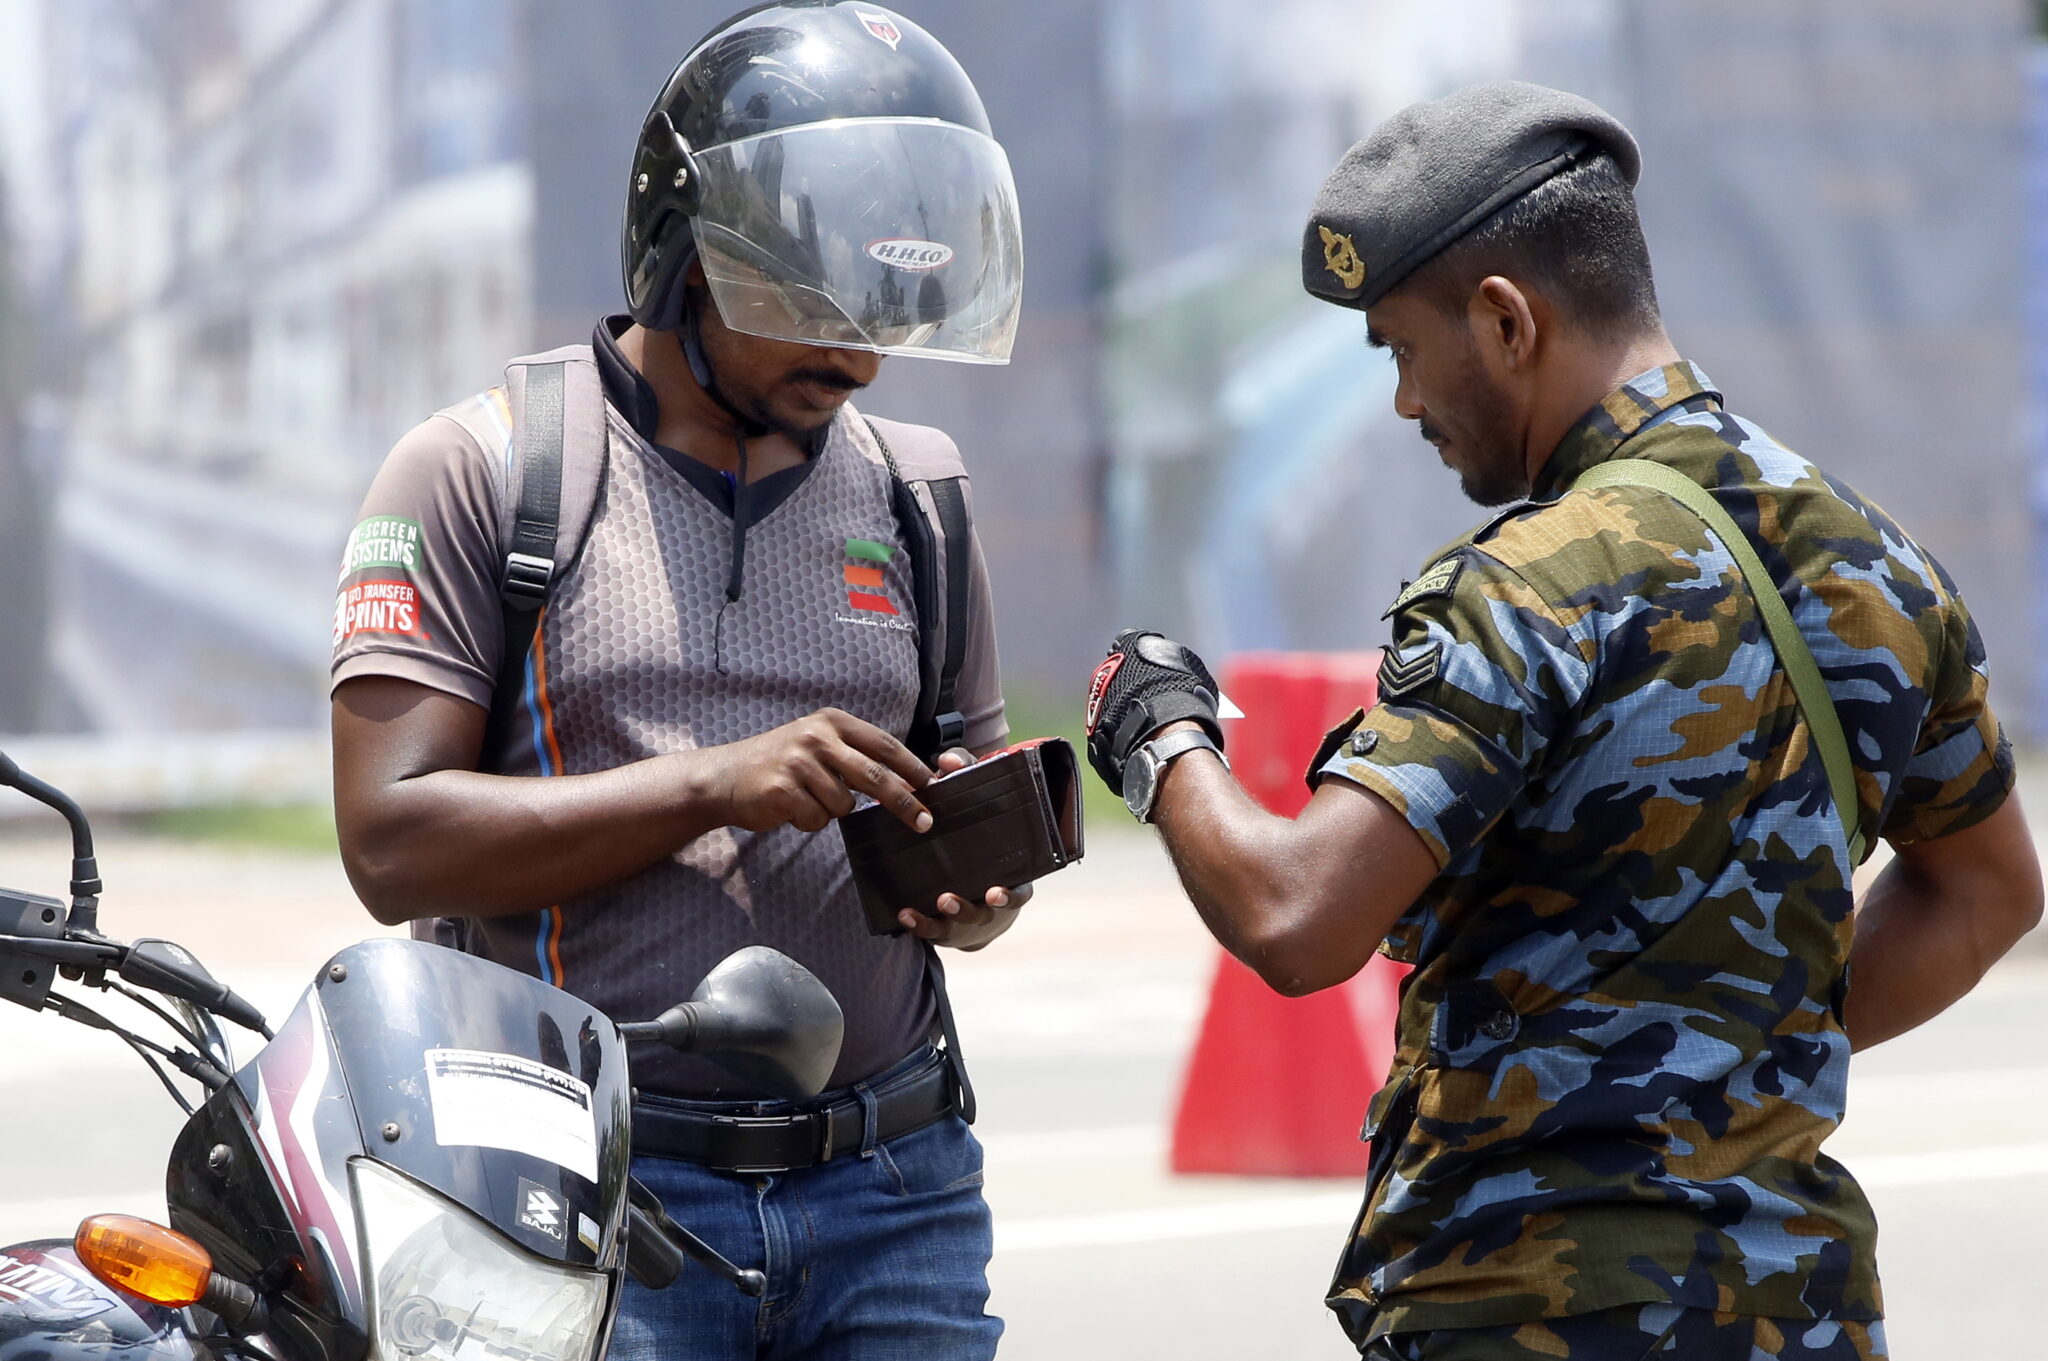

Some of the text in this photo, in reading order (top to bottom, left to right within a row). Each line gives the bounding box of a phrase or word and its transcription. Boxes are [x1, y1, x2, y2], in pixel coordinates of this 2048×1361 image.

[351, 535, 416, 567] SYSTEMS
[348, 583, 414, 606] ECO TRANSFER
[345, 600, 414, 634] PRINTS
[879, 618, 888, 628] is
[522, 1215, 562, 1240] BAJAJ
